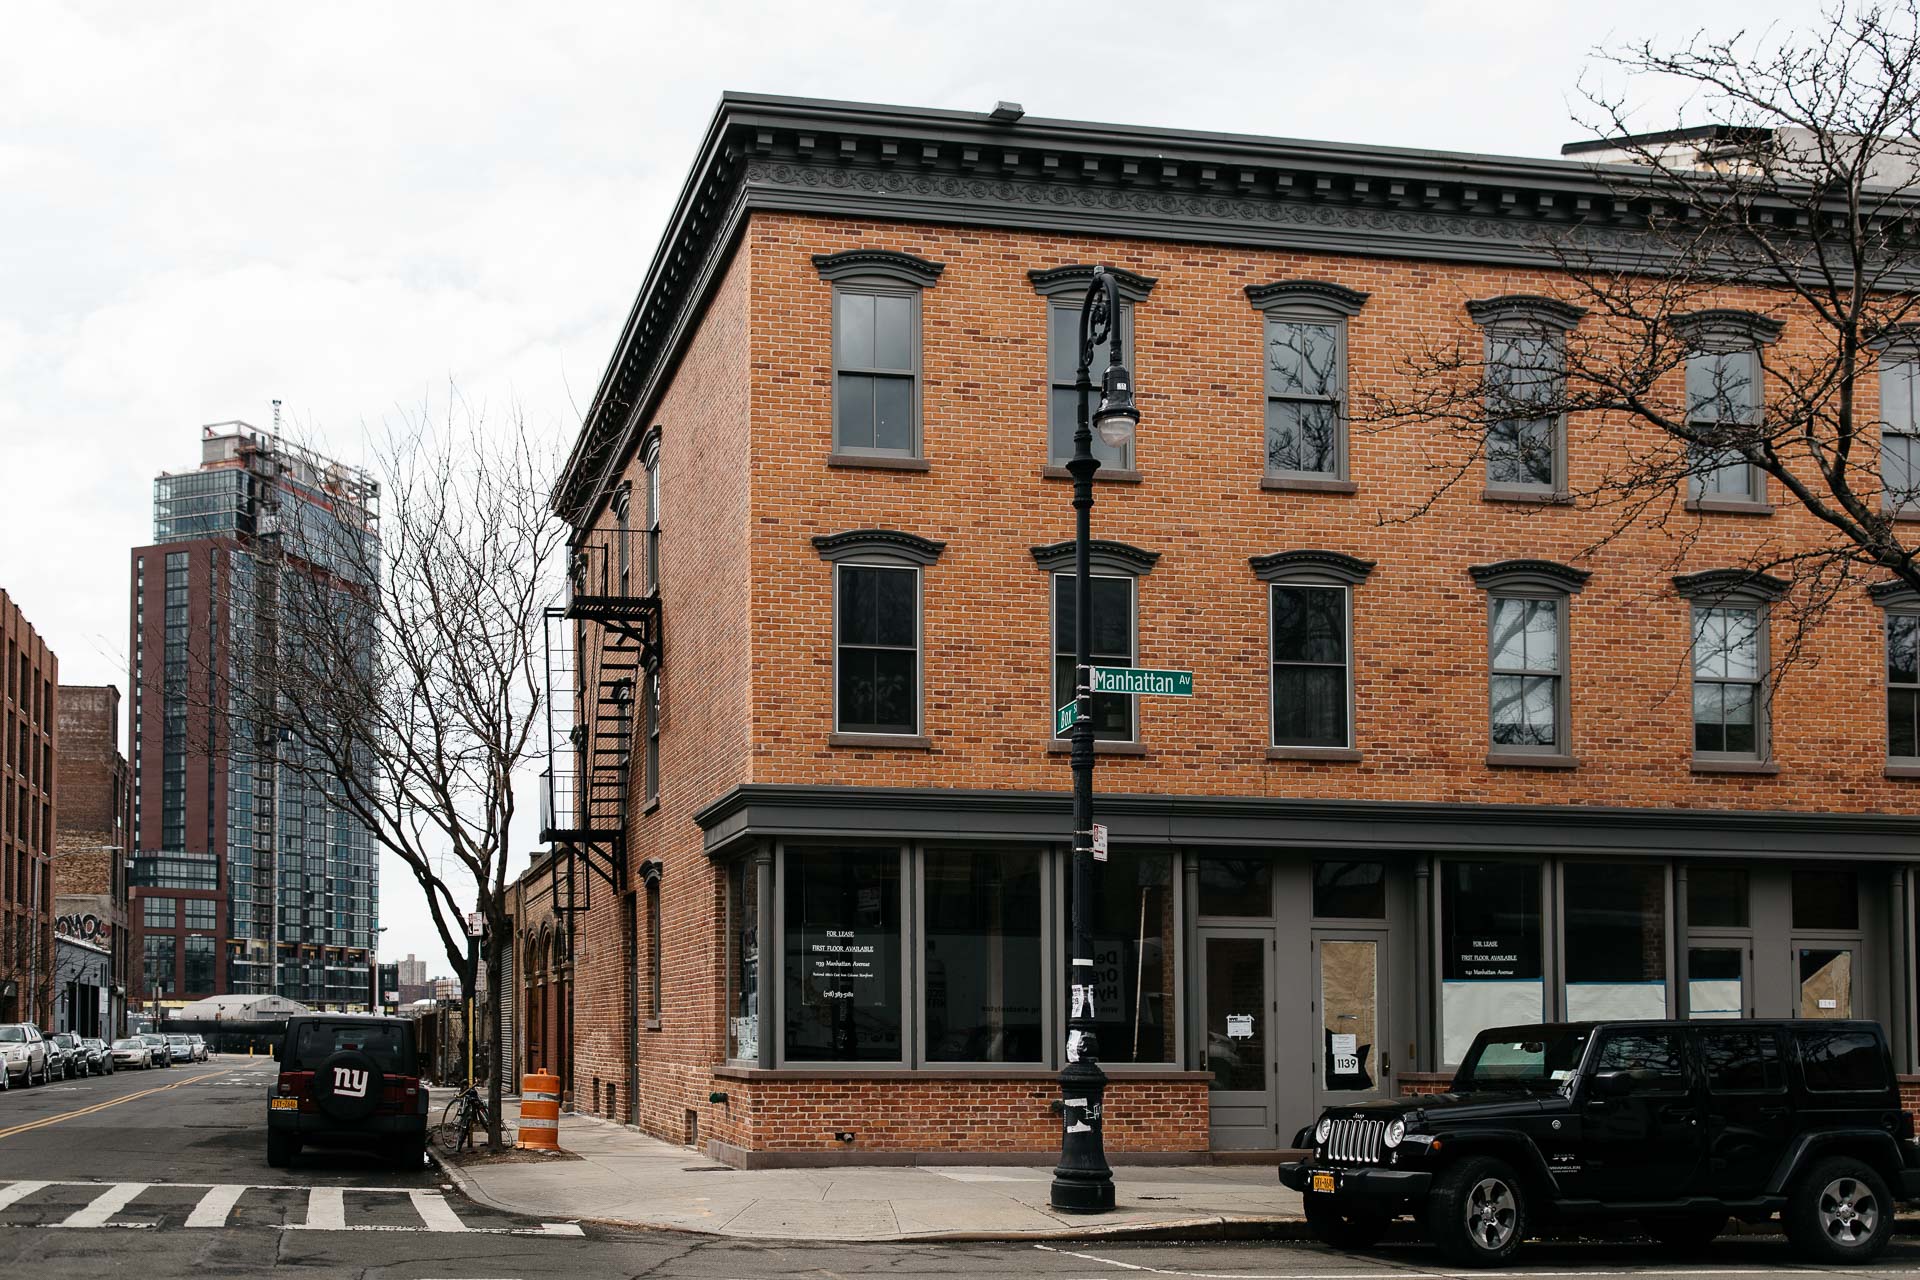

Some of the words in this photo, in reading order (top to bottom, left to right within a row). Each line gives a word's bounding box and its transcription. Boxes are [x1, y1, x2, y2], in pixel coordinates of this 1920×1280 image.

[1095, 670, 1174, 693] Manhattan
[1179, 674, 1190, 686] Av
[1060, 709, 1072, 729] Box
[1337, 1058, 1357, 1069] 1139
[334, 1067, 369, 1098] ny
